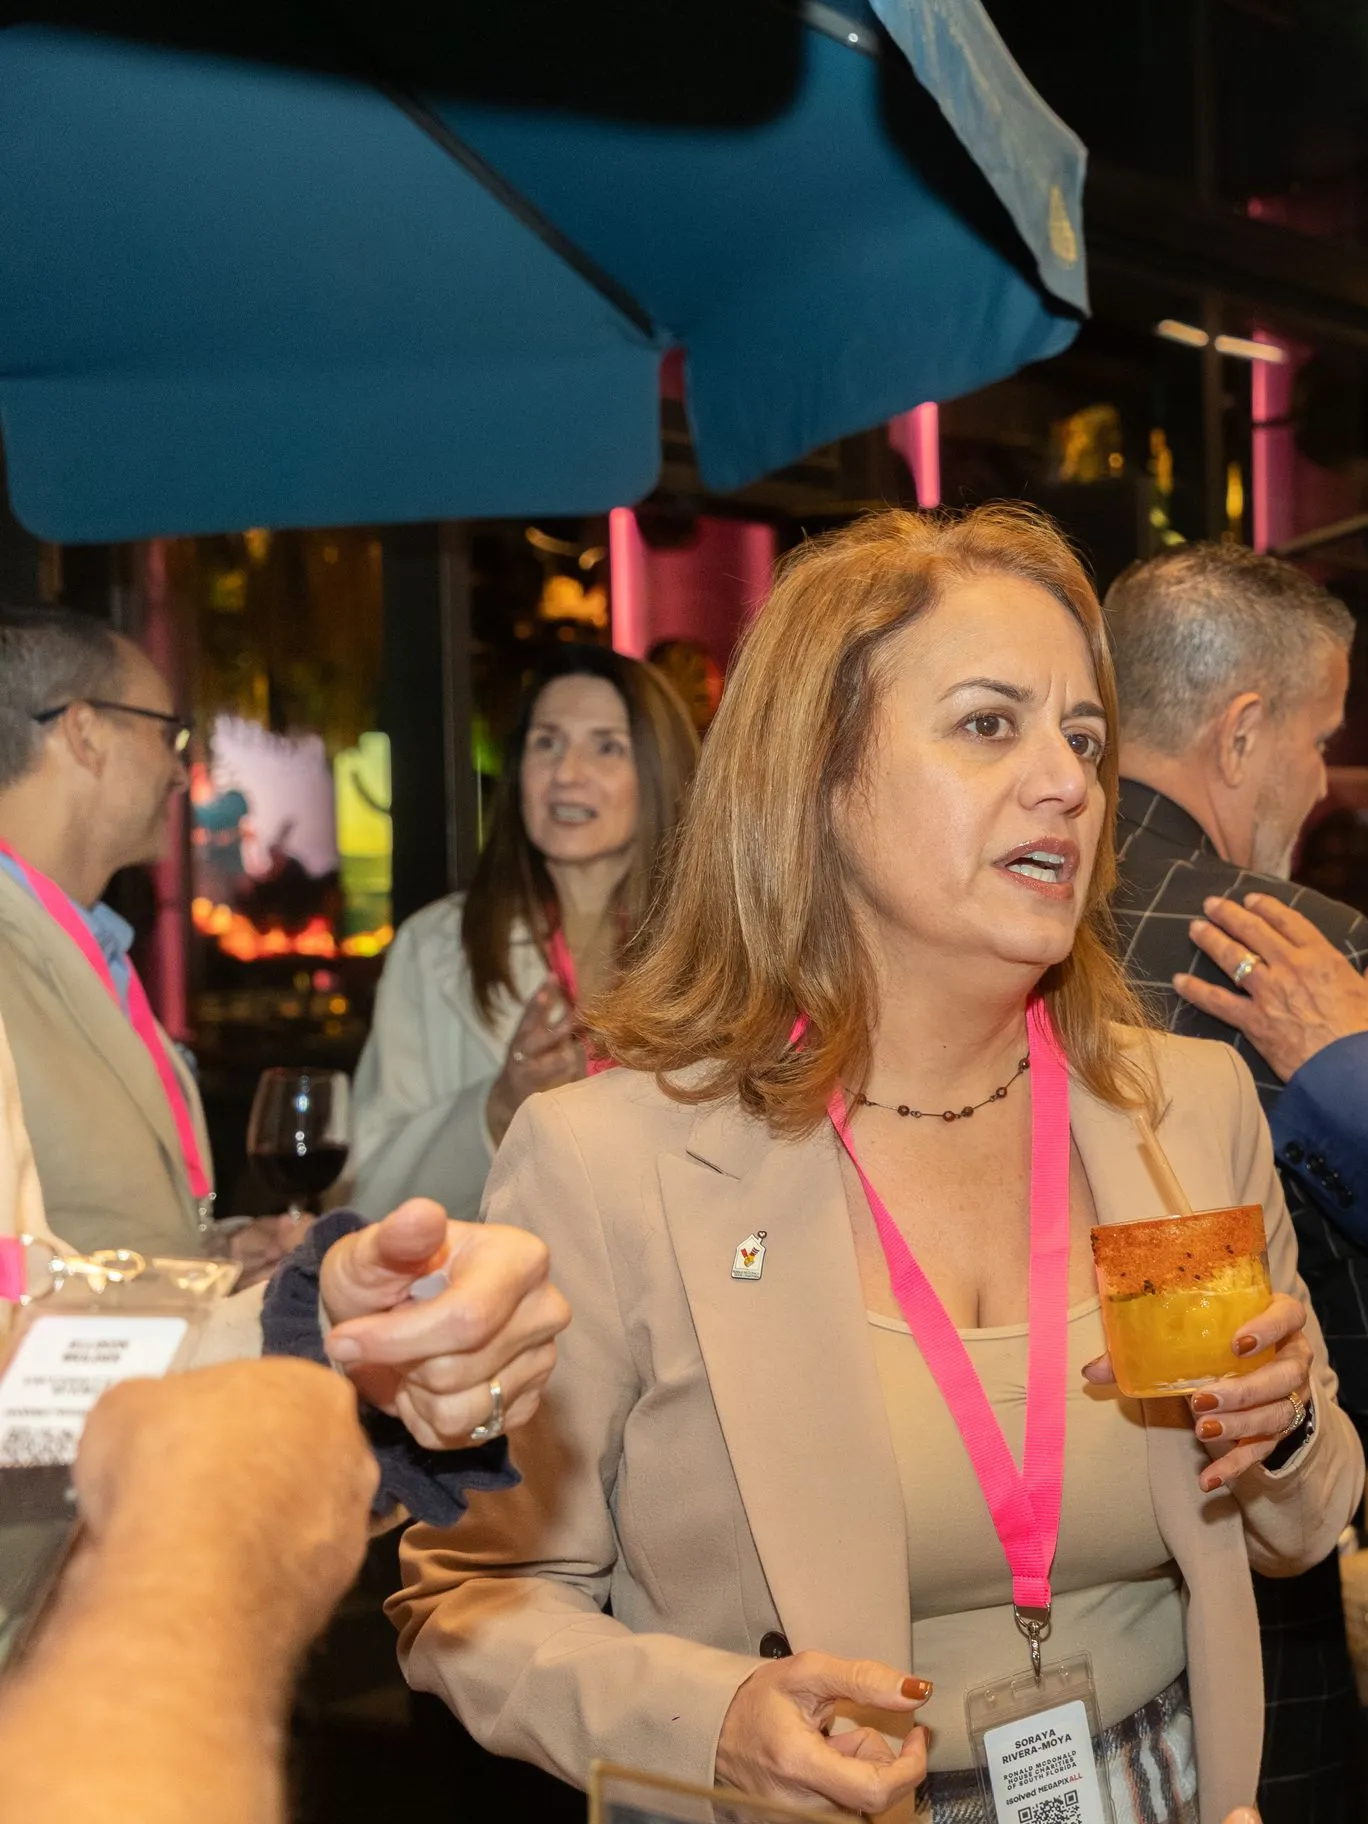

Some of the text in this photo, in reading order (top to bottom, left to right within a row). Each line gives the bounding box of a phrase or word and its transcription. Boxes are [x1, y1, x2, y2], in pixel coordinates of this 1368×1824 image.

[1002, 1734, 1072, 1765] RIVERA-MOYA
[1015, 1729, 1056, 1750] SORAYA
[1003, 1751, 1076, 1781] RONALD MCDONALD
[1007, 1762, 1077, 1791] OF SOUTH FLORIDA
[1008, 1757, 1074, 1785] HOUSE CHARITIES
